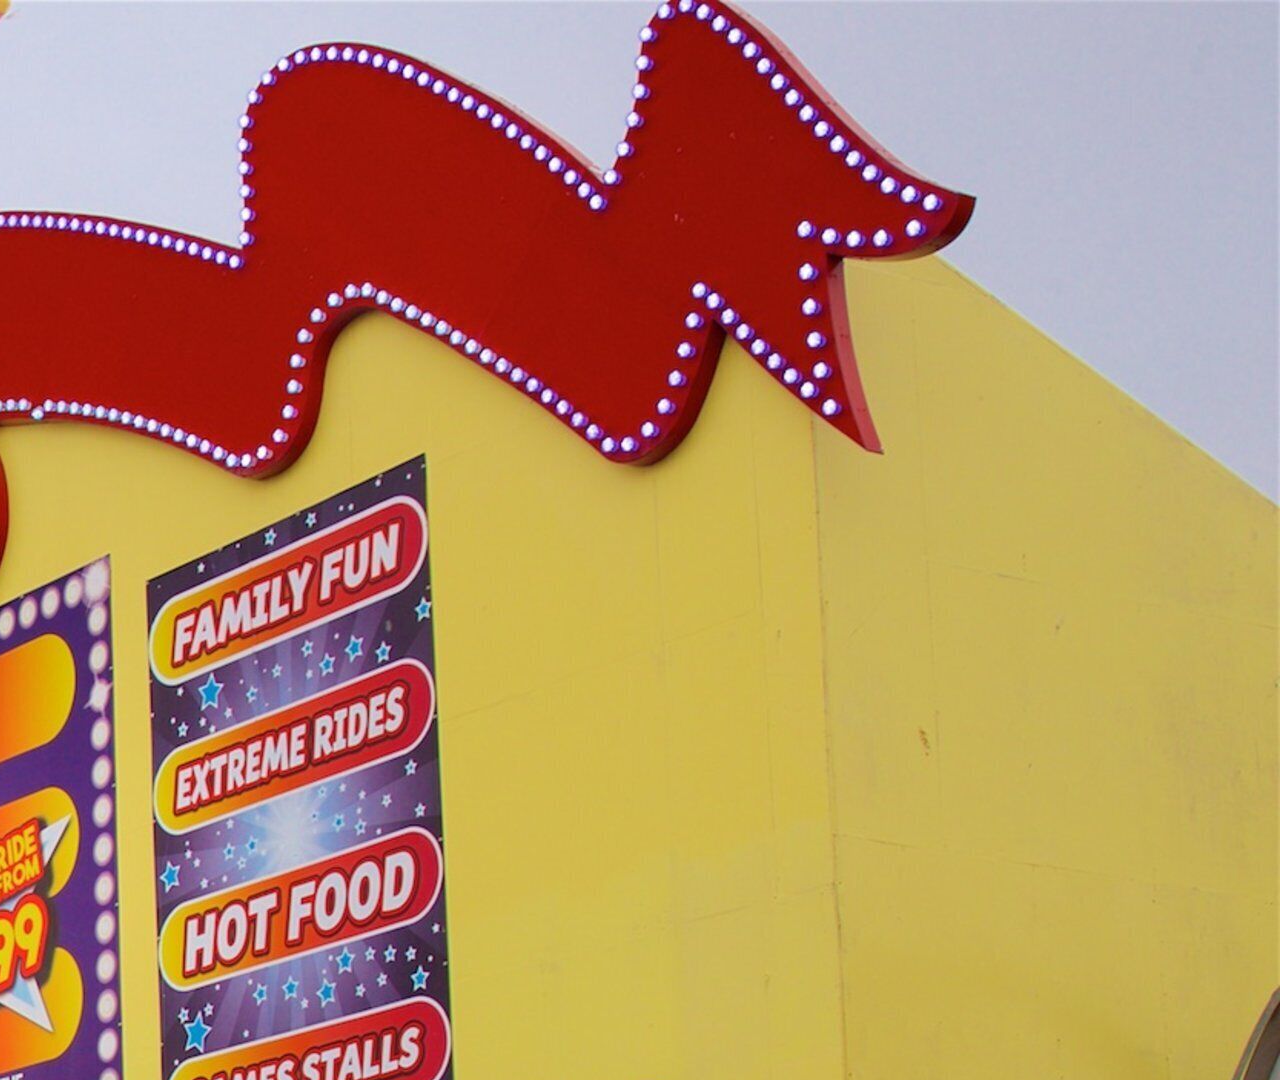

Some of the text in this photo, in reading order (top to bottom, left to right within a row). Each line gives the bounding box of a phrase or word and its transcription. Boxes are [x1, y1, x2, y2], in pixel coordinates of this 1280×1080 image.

[172, 524, 402, 664] FAMILY FUN
[174, 685, 405, 813] EXTREME RIDES
[183, 848, 416, 975] HOT FOOD
